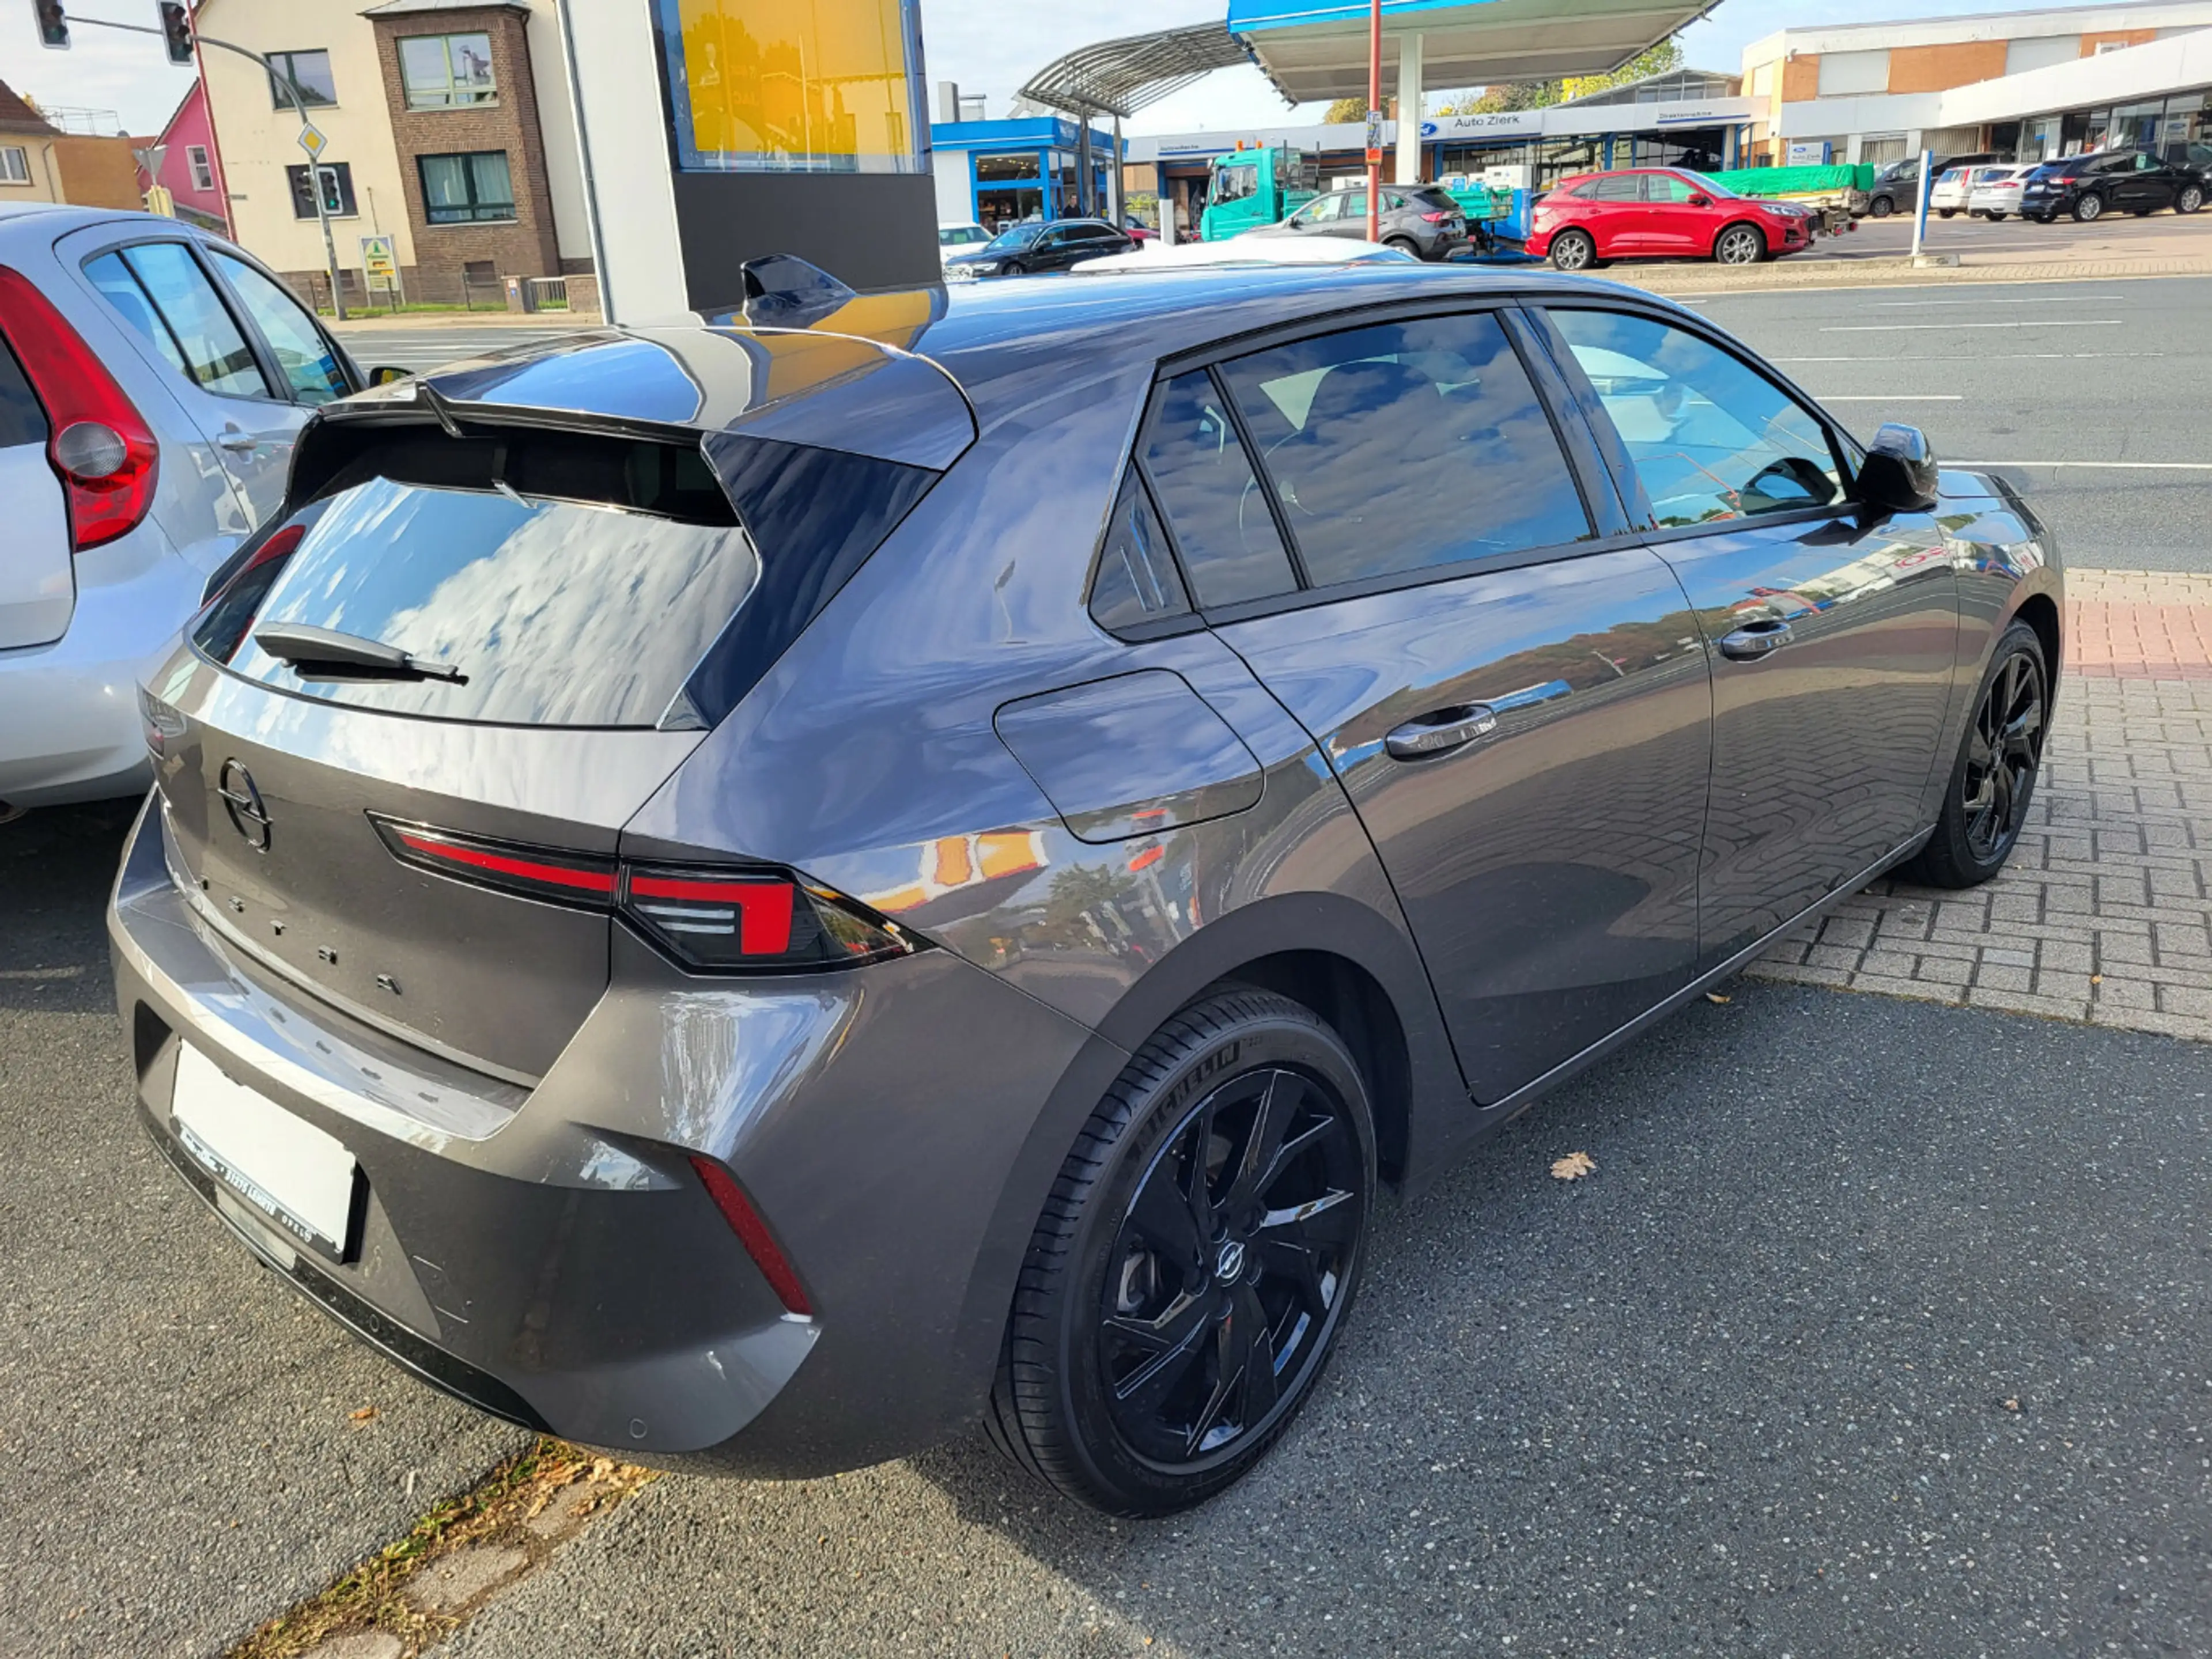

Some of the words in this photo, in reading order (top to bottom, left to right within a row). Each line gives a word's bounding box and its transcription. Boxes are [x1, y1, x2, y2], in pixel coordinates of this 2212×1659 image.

[1454, 118, 1484, 128] Auto
[1487, 115, 1520, 126] Zierk
[1137, 1040, 1241, 1150] MICHELIN
